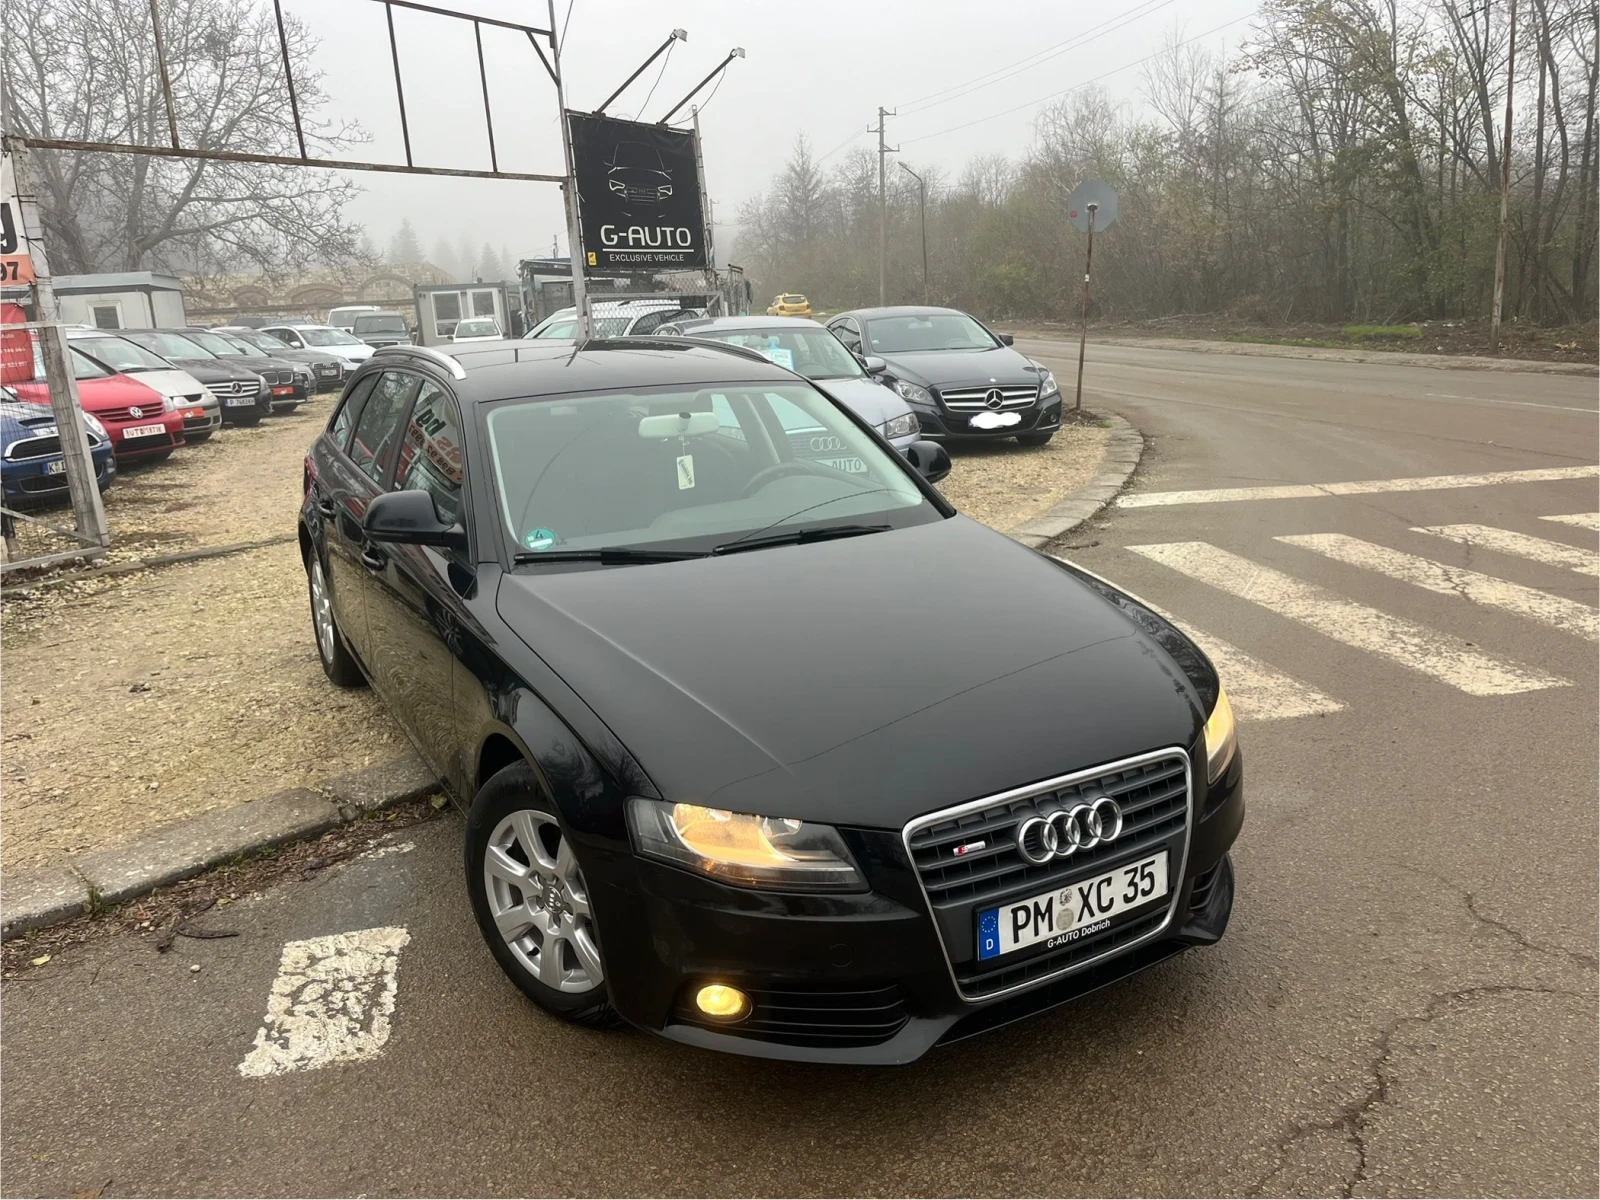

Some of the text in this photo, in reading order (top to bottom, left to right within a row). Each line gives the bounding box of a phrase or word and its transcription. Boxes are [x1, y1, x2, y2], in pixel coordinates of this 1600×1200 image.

[600, 225, 691, 246] G-AUTO
[654, 254, 684, 262] VEHICLE
[47, 459, 55, 473] K
[1011, 859, 1156, 944] PM XC 35
[1047, 919, 1111, 949] G-AUTO Dobrich
[986, 938, 994, 950] D
